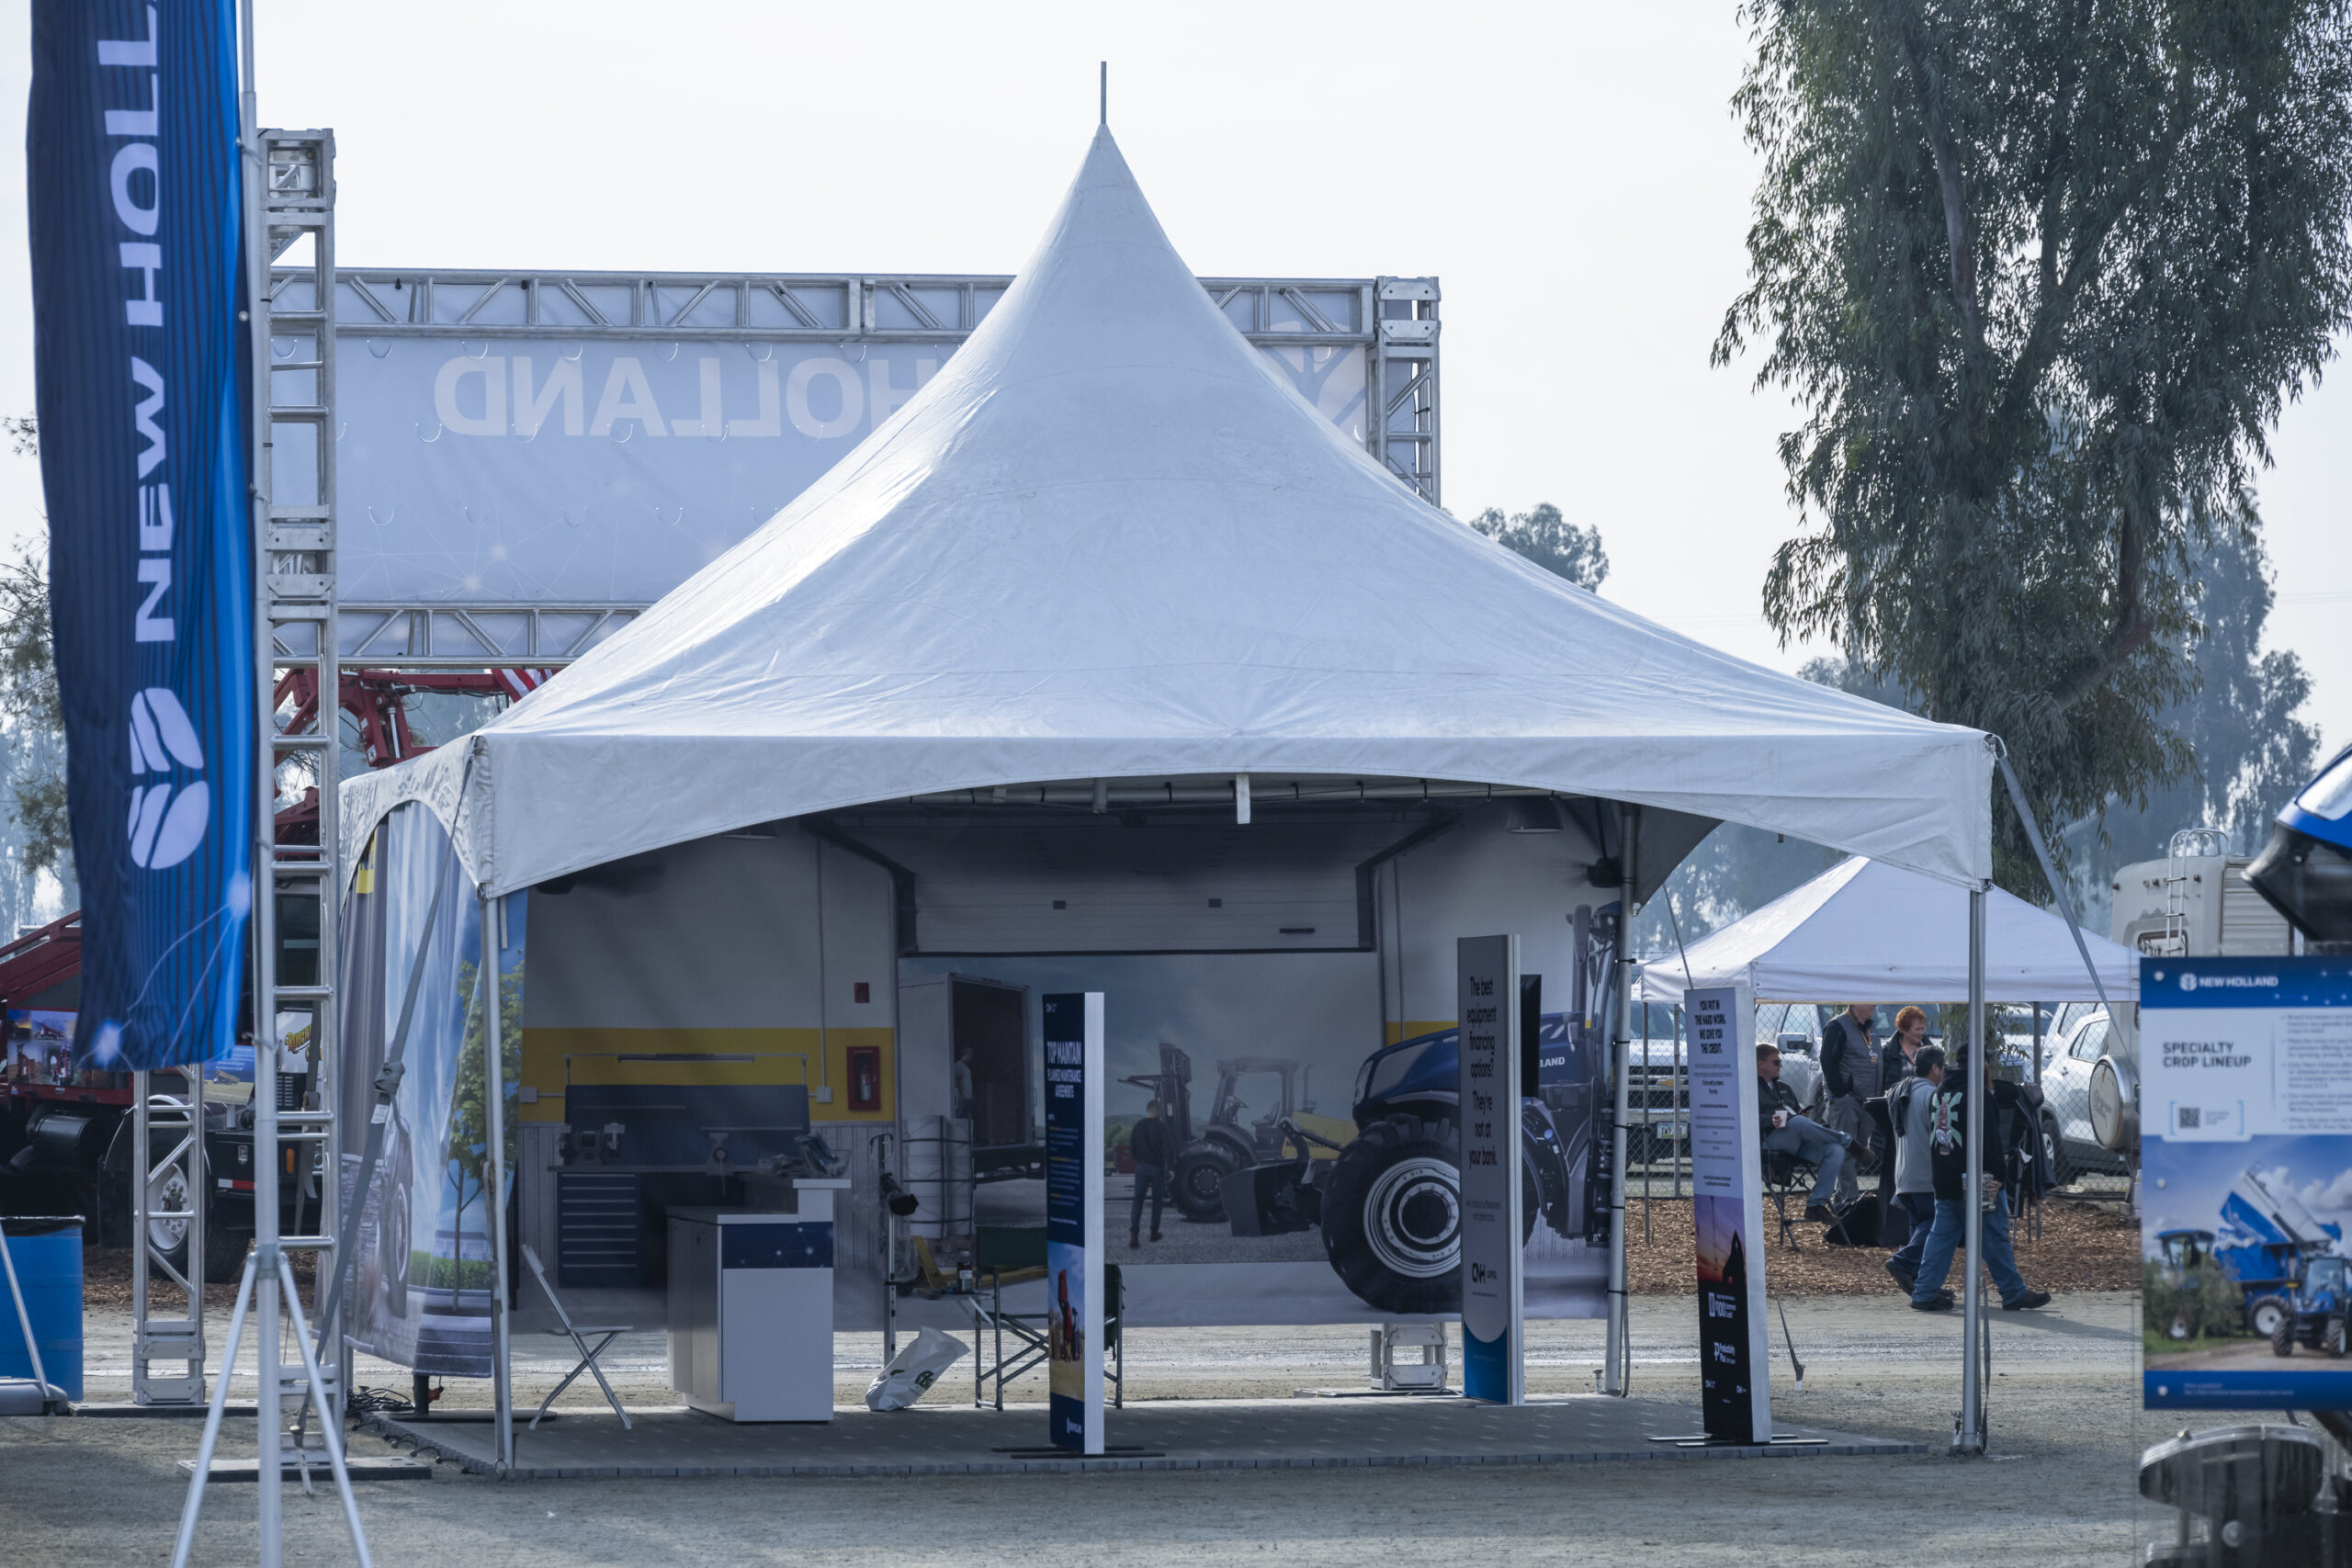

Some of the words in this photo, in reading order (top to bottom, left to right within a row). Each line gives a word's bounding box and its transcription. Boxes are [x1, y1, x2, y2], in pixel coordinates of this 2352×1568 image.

[96, 0, 164, 328] HOLL
[130, 356, 175, 642] NEW
[1469, 976, 1480, 997] The
[1481, 976, 1494, 997] best
[2199, 976, 2225, 987] NEW
[2227, 976, 2279, 987] HOLLAND
[1467, 1004, 1497, 1028] equipment
[1469, 1030, 1495, 1055] financing
[2162, 1041, 2235, 1055] SPECIALTY
[1470, 1057, 1495, 1084] options?
[1539, 1055, 1566, 1067] LAND
[2163, 1055, 2199, 1068] CROP
[2202, 1055, 2252, 1068] LINEUP
[1475, 1120, 1485, 1138] not
[1485, 1120, 1492, 1138] at
[1468, 1149, 1481, 1169] your
